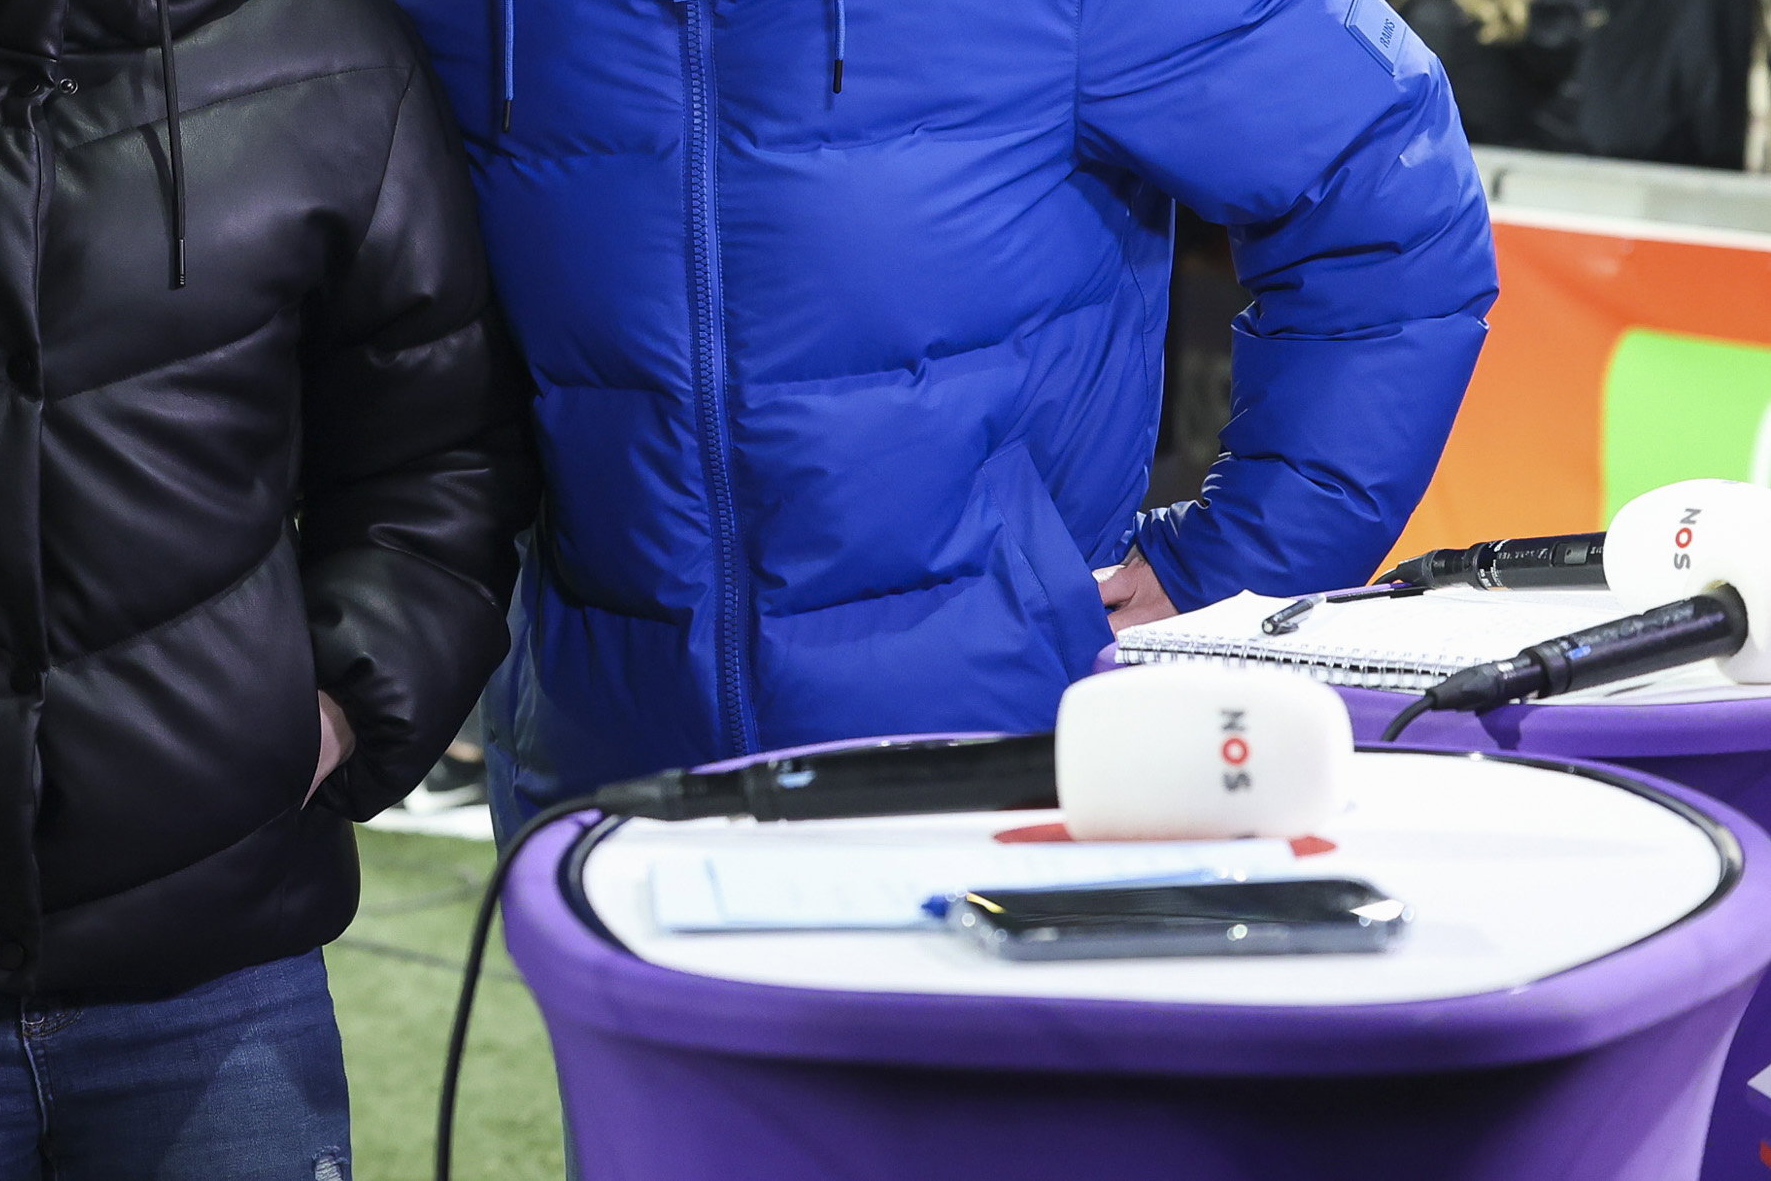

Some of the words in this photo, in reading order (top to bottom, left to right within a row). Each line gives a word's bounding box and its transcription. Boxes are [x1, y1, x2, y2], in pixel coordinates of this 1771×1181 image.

[1379, 18, 1396, 49] RAINS
[1673, 507, 1702, 570] NOS
[1220, 708, 1252, 792] NOS
